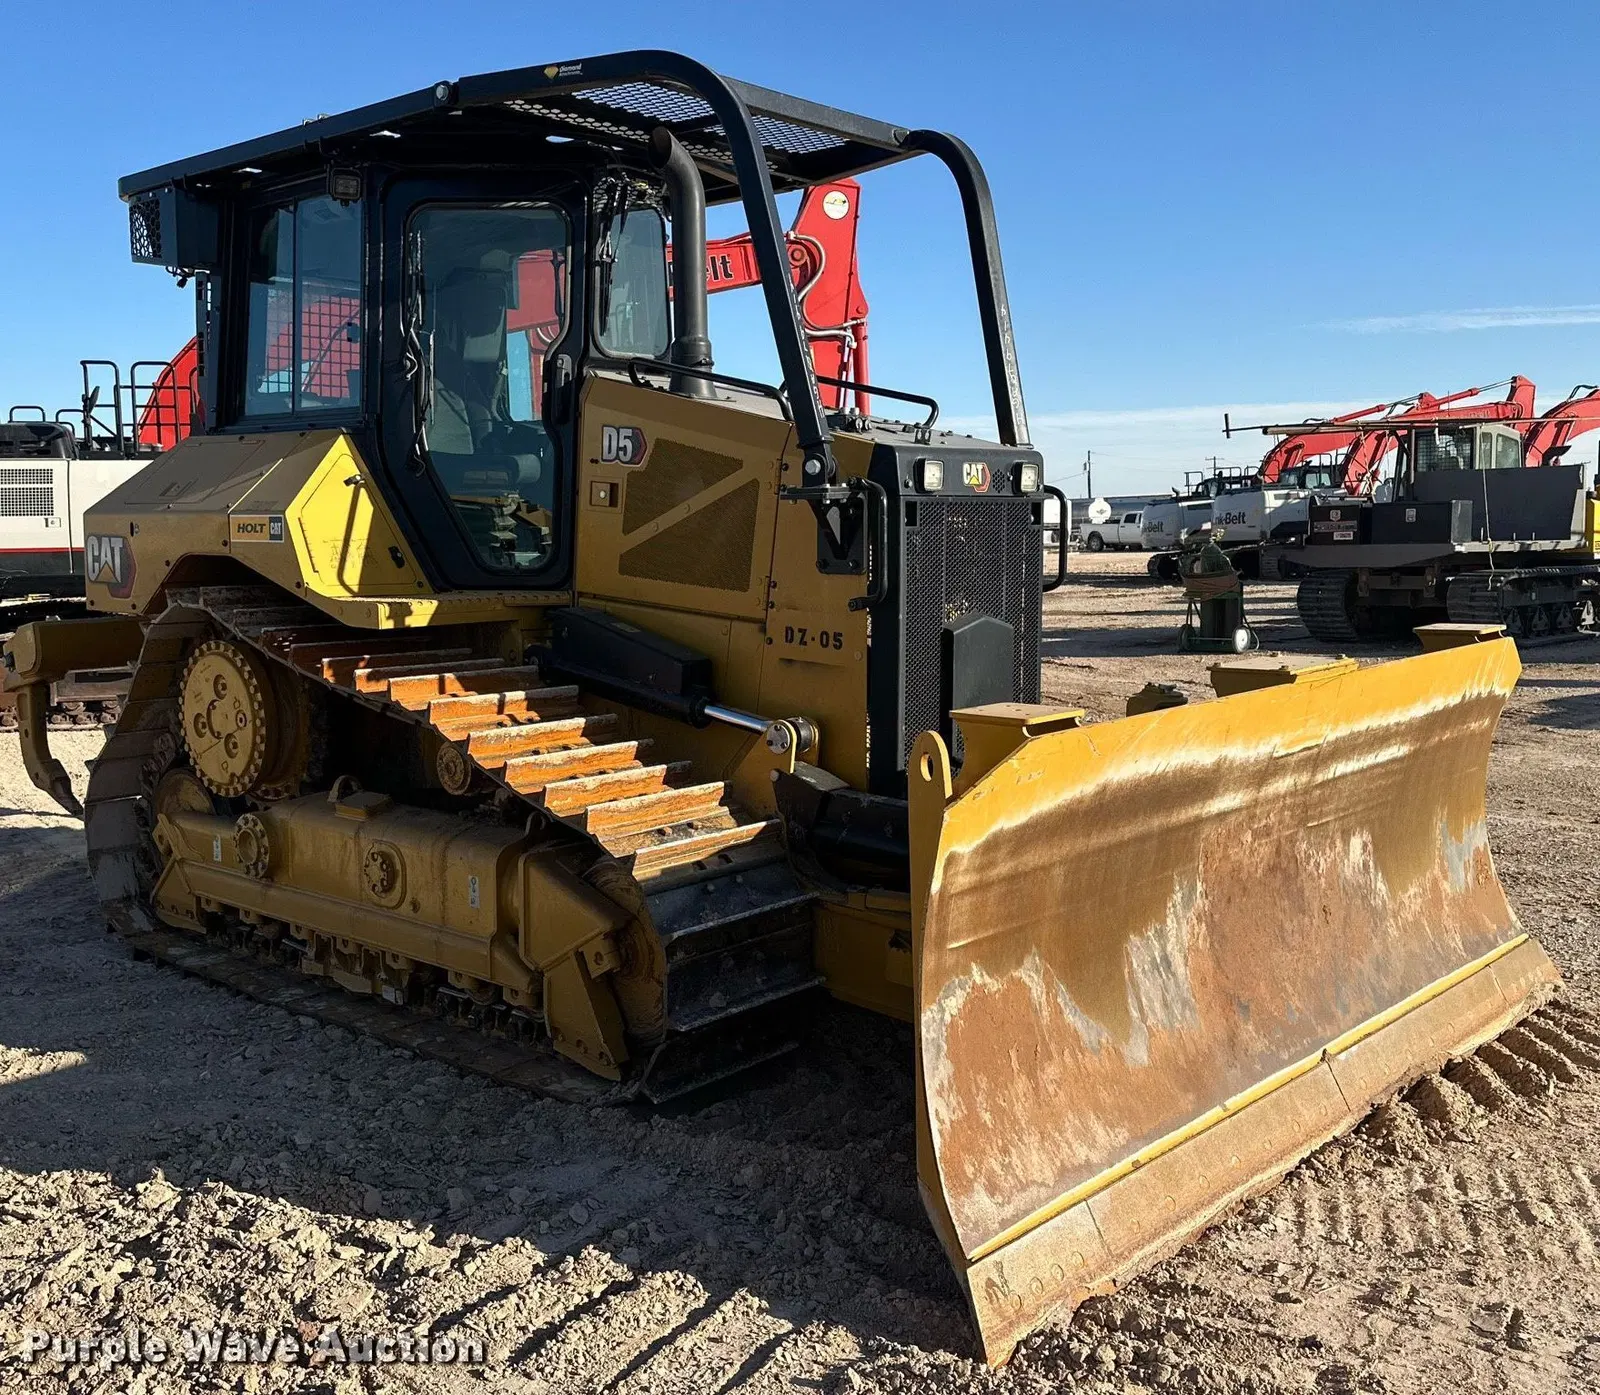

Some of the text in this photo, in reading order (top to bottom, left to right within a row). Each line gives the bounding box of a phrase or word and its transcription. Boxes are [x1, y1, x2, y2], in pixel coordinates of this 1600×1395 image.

[602, 426, 633, 462] D5
[963, 463, 984, 486] CAT
[237, 522, 281, 535] HOLT CAT
[87, 535, 123, 583] CAT
